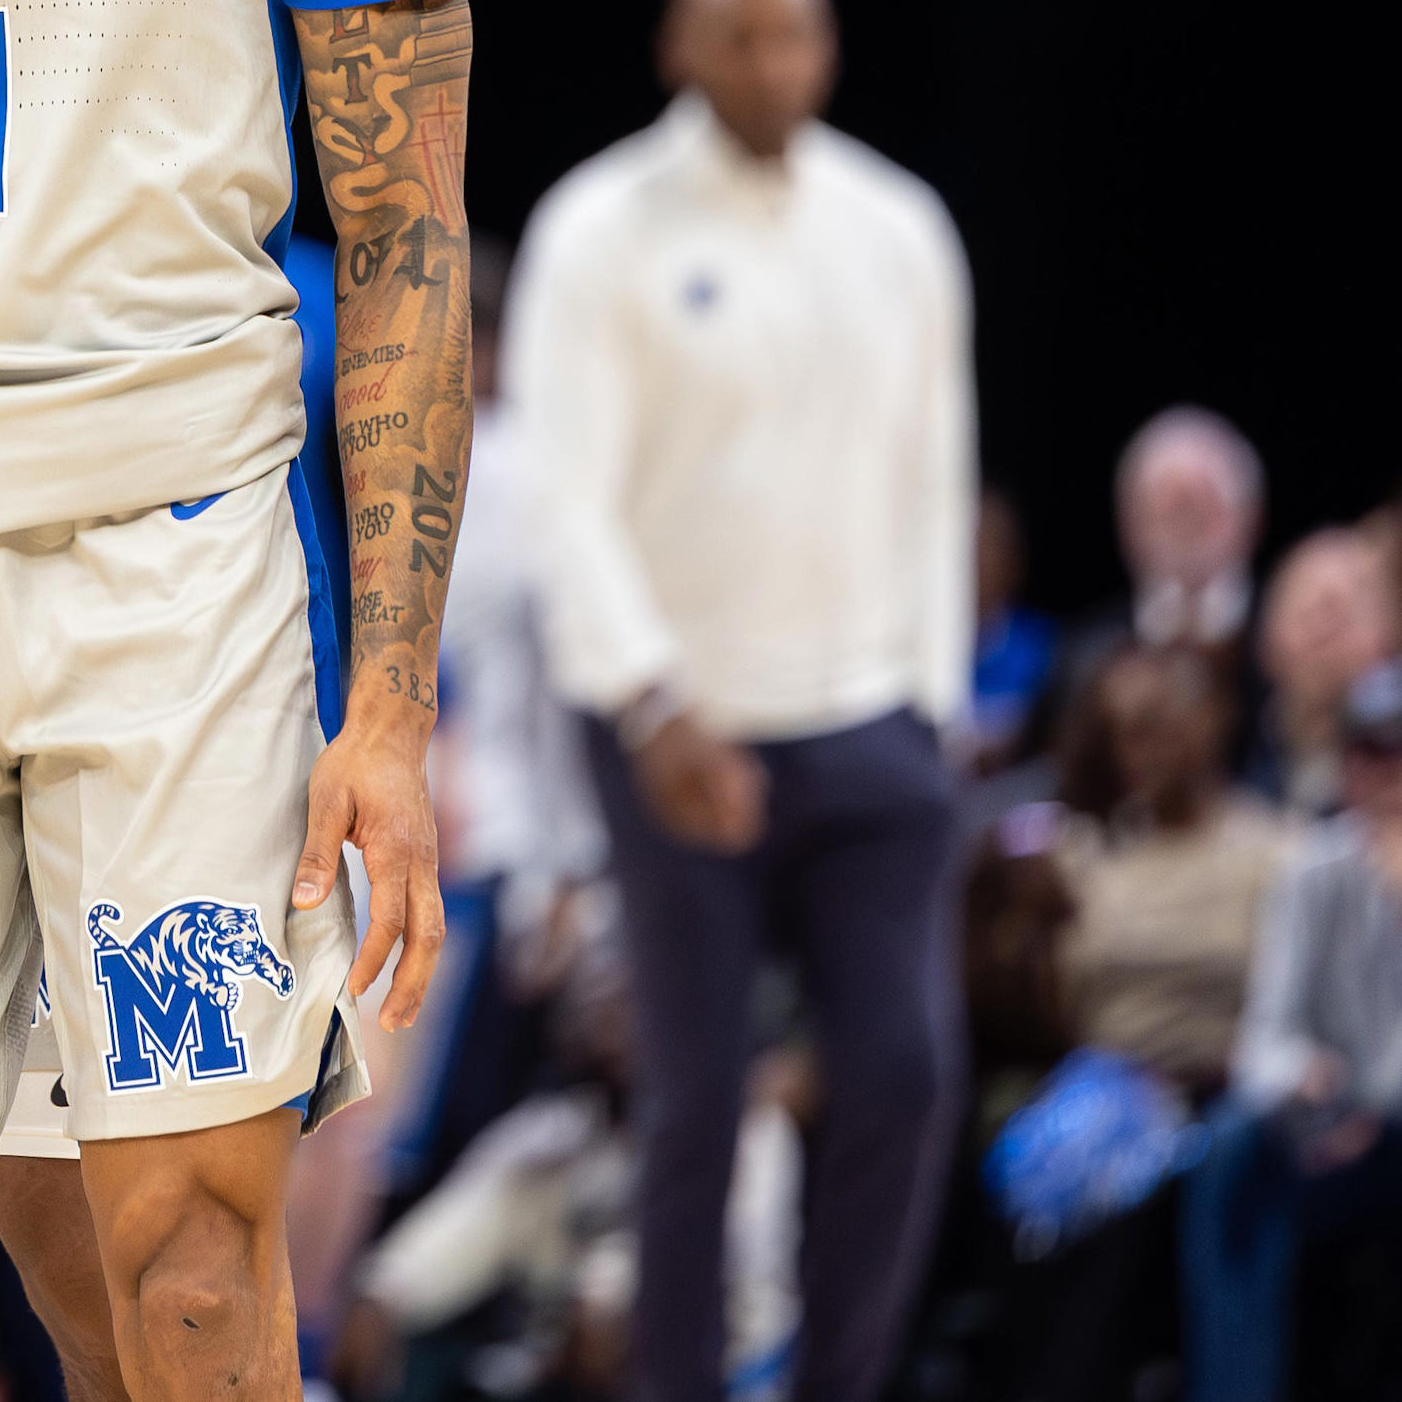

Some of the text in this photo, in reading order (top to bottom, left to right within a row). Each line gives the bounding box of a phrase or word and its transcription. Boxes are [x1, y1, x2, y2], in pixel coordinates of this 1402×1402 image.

[341, 344, 406, 377] ENEMIES
[356, 502, 394, 524] WHO
[356, 520, 390, 544] YOU
